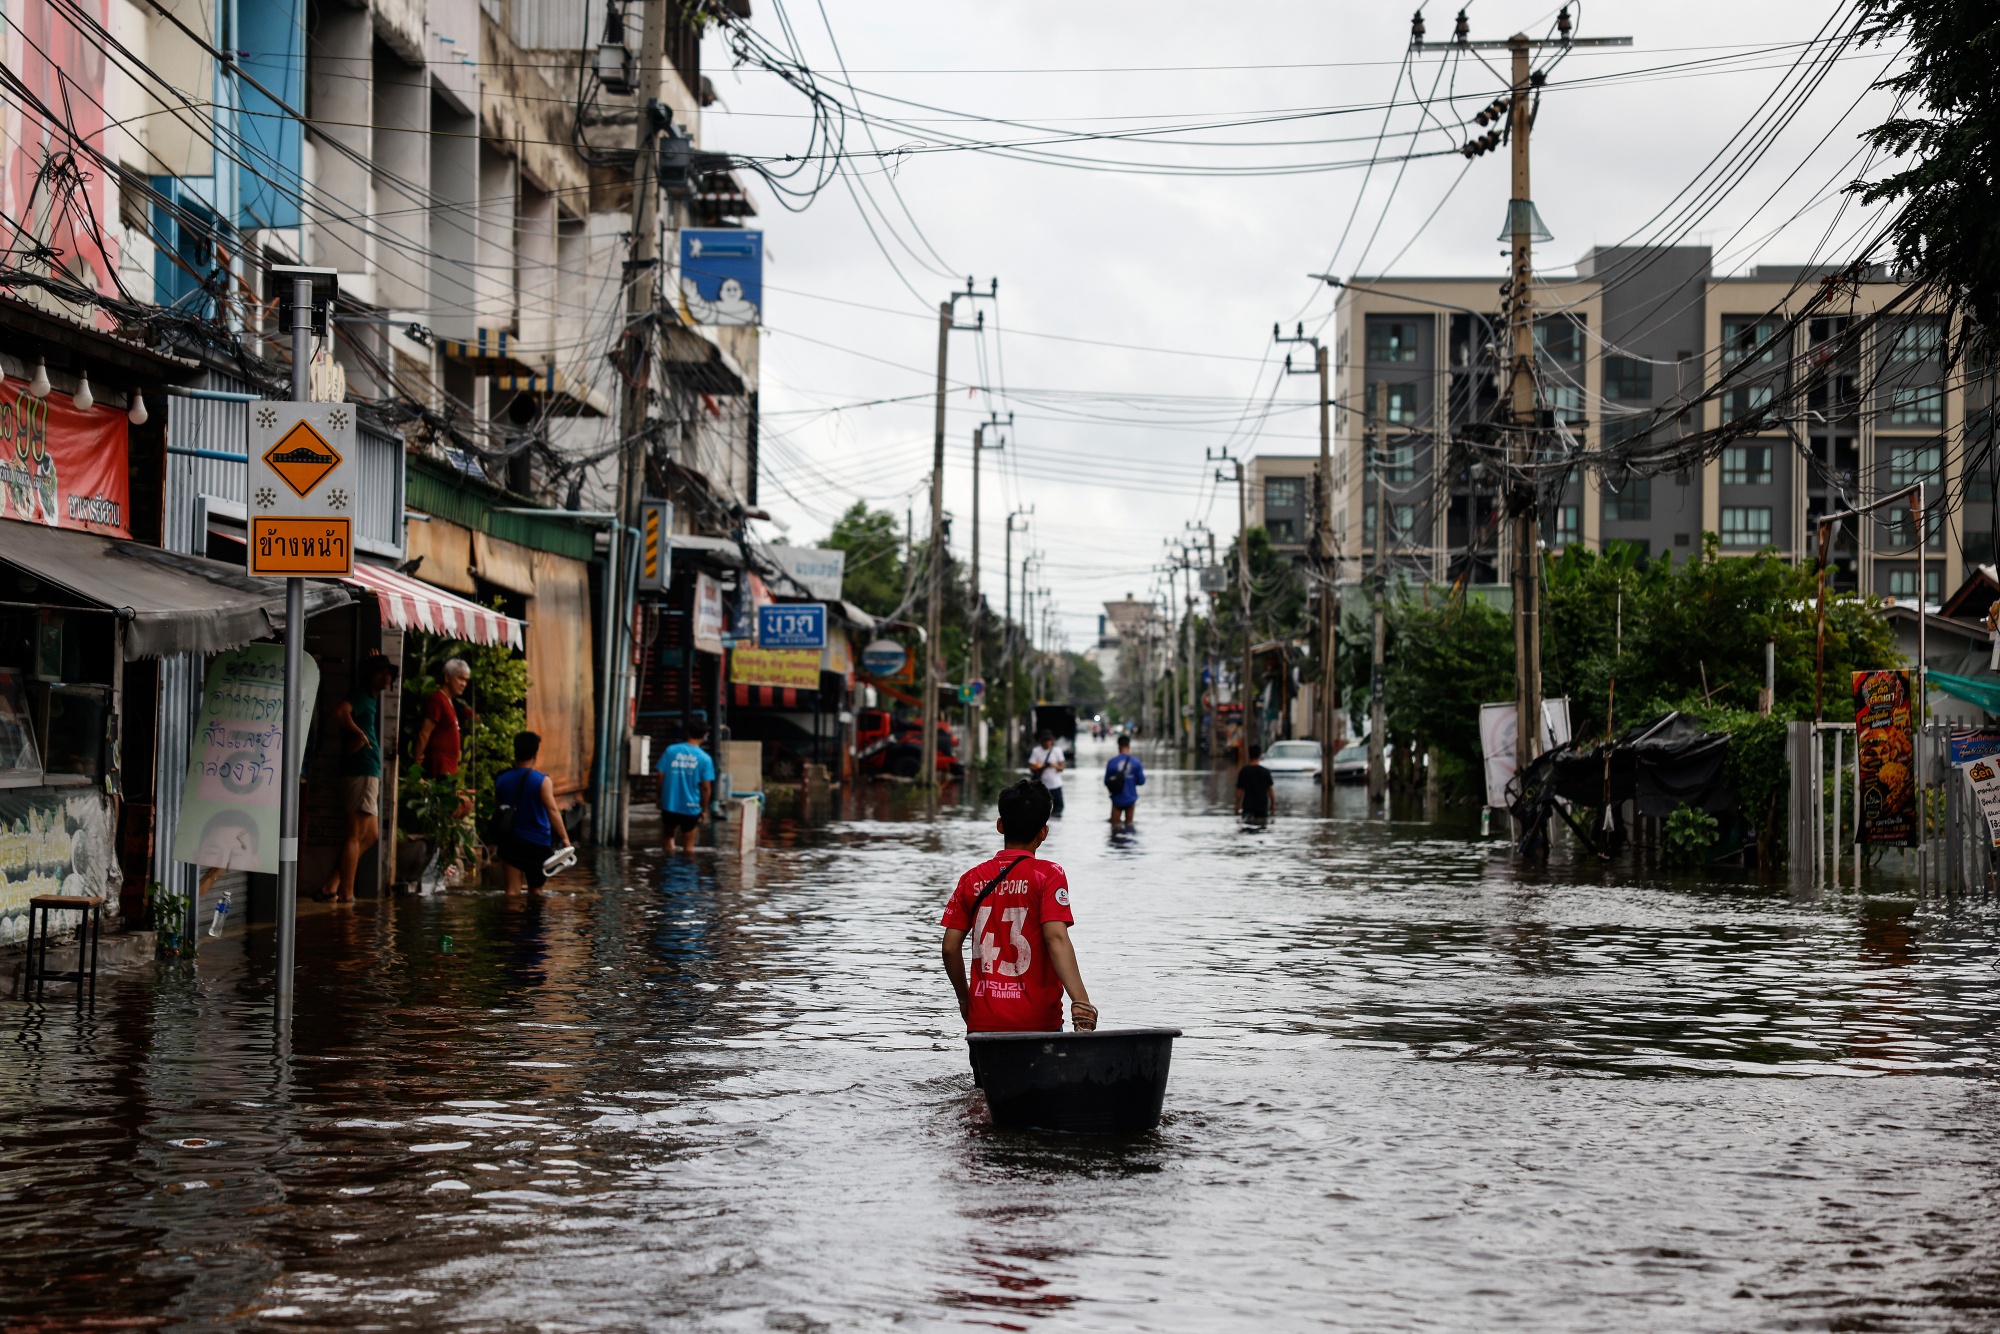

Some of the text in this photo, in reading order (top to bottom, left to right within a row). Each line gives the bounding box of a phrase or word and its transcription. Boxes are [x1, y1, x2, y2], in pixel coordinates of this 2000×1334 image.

[67, 493, 121, 526] อาหารอีสาน
[260, 528, 344, 557] ข้างหน้า
[972, 906, 1032, 977] 43
[985, 981, 1026, 991] ISUZU
[991, 990, 1021, 999] RANONG
